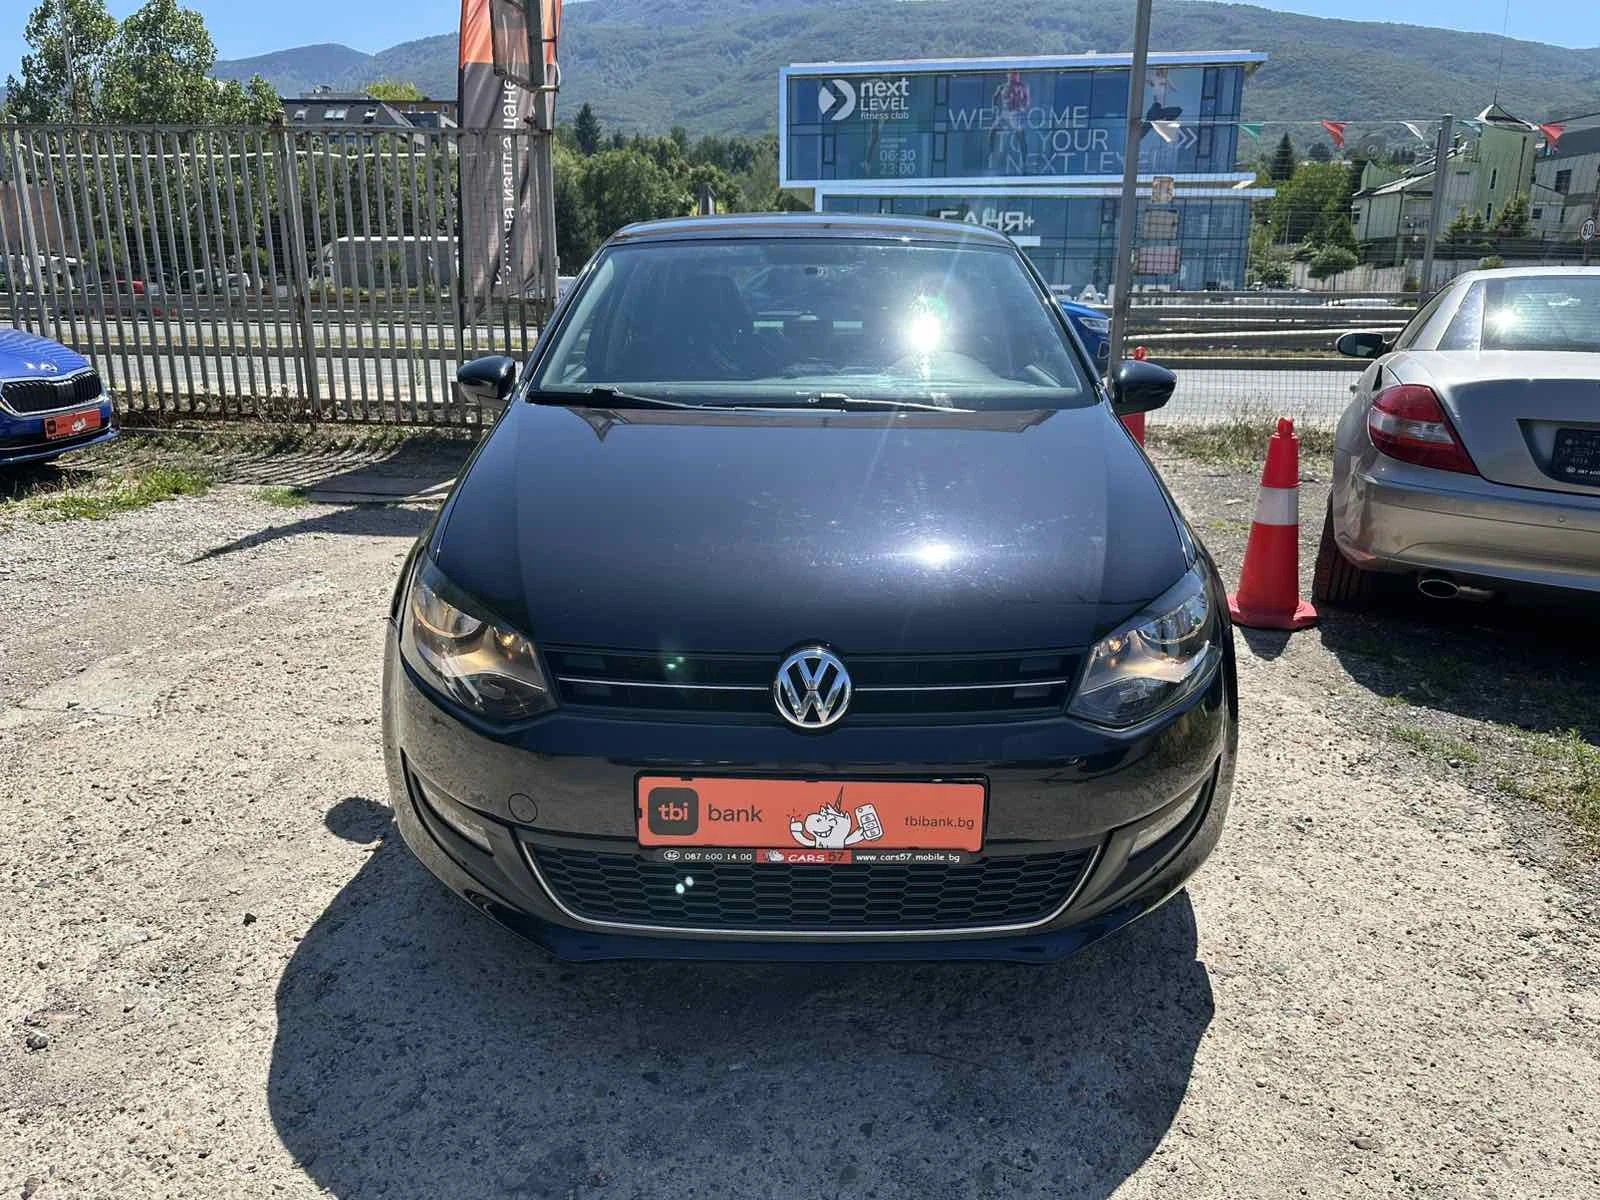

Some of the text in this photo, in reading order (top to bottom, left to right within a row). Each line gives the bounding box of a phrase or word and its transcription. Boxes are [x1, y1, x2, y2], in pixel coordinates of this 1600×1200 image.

[860, 77, 910, 97] next
[860, 97, 909, 111] LEVEL
[948, 106, 1088, 130] WECOME
[1036, 128, 1109, 152] YOUR
[1006, 151, 1077, 175] NEXT
[658, 801, 763, 822] tbi bank
[904, 816, 975, 830] tbibank.bg
[705, 852, 723, 861] 600
[740, 853, 753, 861] 00
[788, 854, 825, 863] CARS
